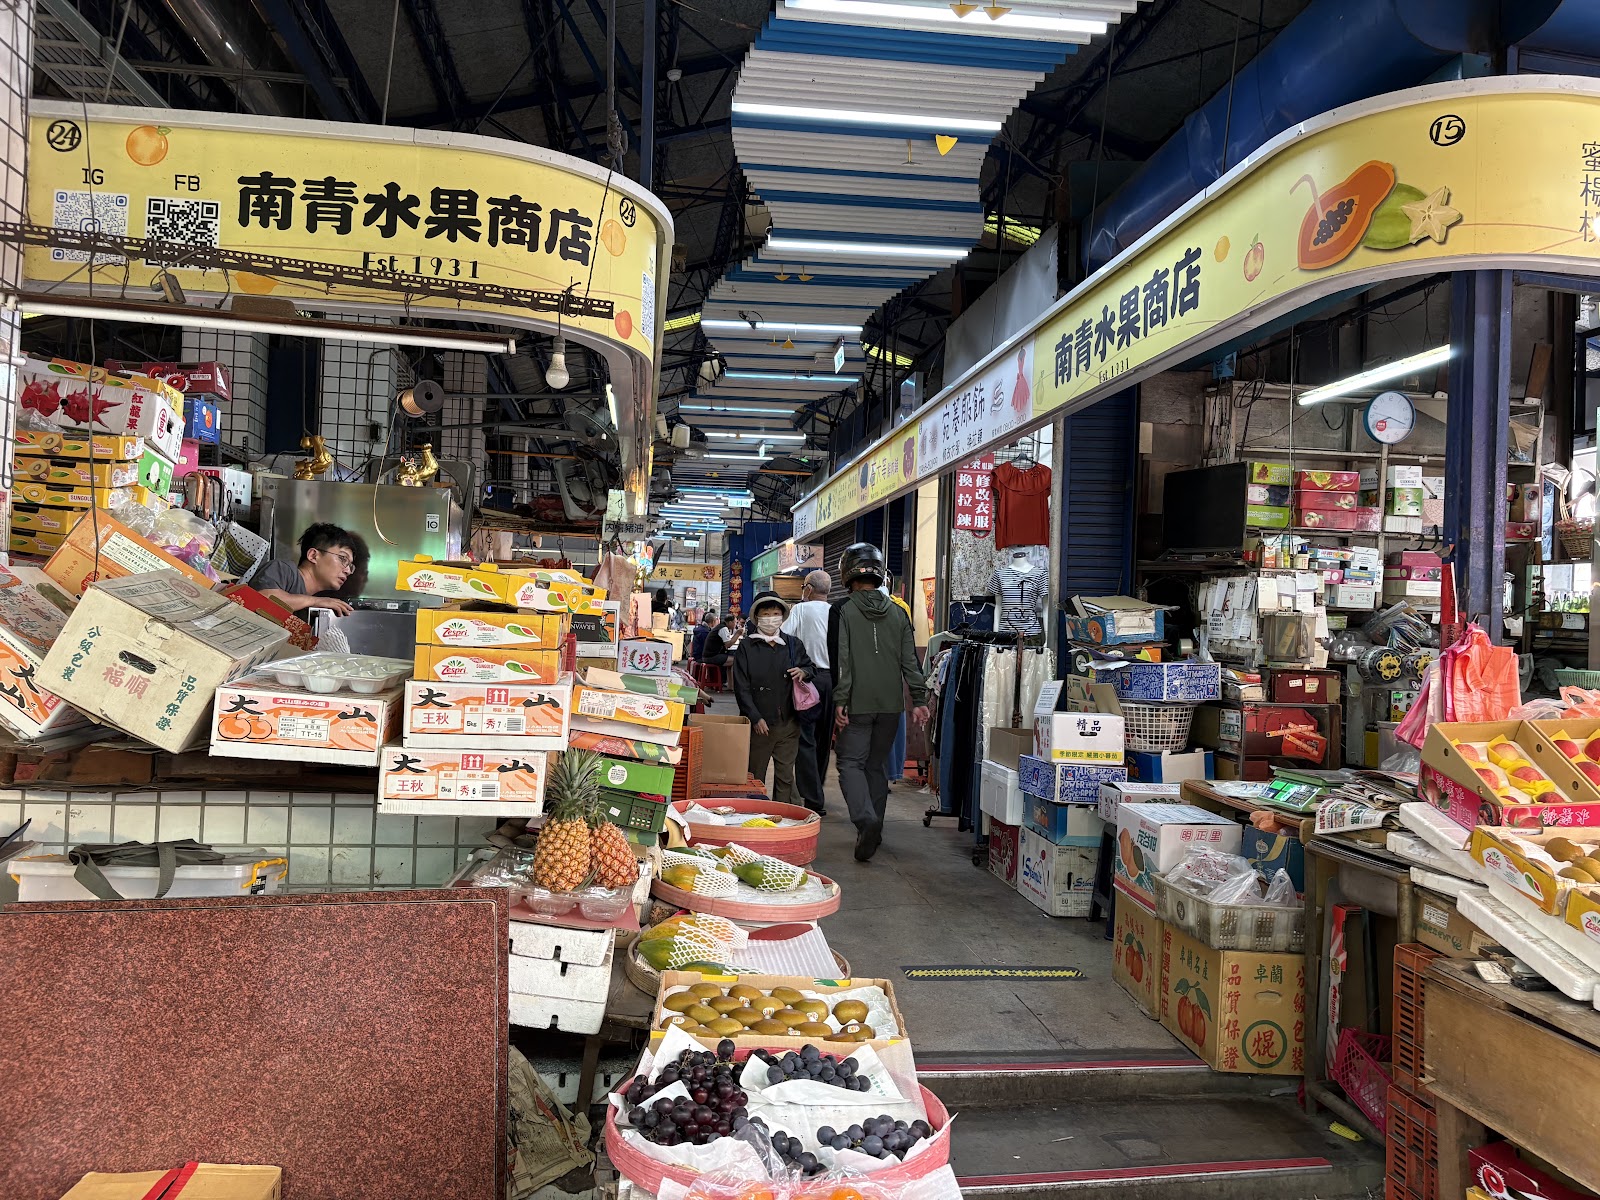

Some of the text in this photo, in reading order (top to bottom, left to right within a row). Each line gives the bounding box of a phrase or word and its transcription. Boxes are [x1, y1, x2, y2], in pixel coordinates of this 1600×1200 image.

[48, 121, 80, 150] 24
[1432, 117, 1464, 144] 15
[82, 169, 104, 185] IG
[174, 175, 201, 192] FB
[237, 171, 597, 267] 南青水果商店
[620, 198, 636, 227] 24
[1054, 247, 1202, 388] 南青水果商店
[127, 392, 144, 430] 紅龍果
[957, 474, 973, 526] 換拉鍊
[974, 475, 991, 528] 修改衣服
[413, 578, 437, 589] Zespri
[442, 627, 468, 638] Zespri
[441, 665, 467, 676] Zespri
[637, 653, 654, 668] 珍
[156, 674, 197, 731] 品質保證
[221, 694, 377, 722] 大 山
[413, 688, 452, 708] 大
[522, 693, 561, 709] 山
[422, 712, 449, 725] 王秋
[1076, 718, 1102, 733] 精品
[386, 754, 536, 774] 大 山
[396, 779, 424, 792] 王秋
[1180, 829, 1223, 842] 明正里
[1486, 853, 1502, 869] Zespri
[1254, 964, 1283, 985] 卓蘭
[1223, 963, 1242, 1070] 品質保證
